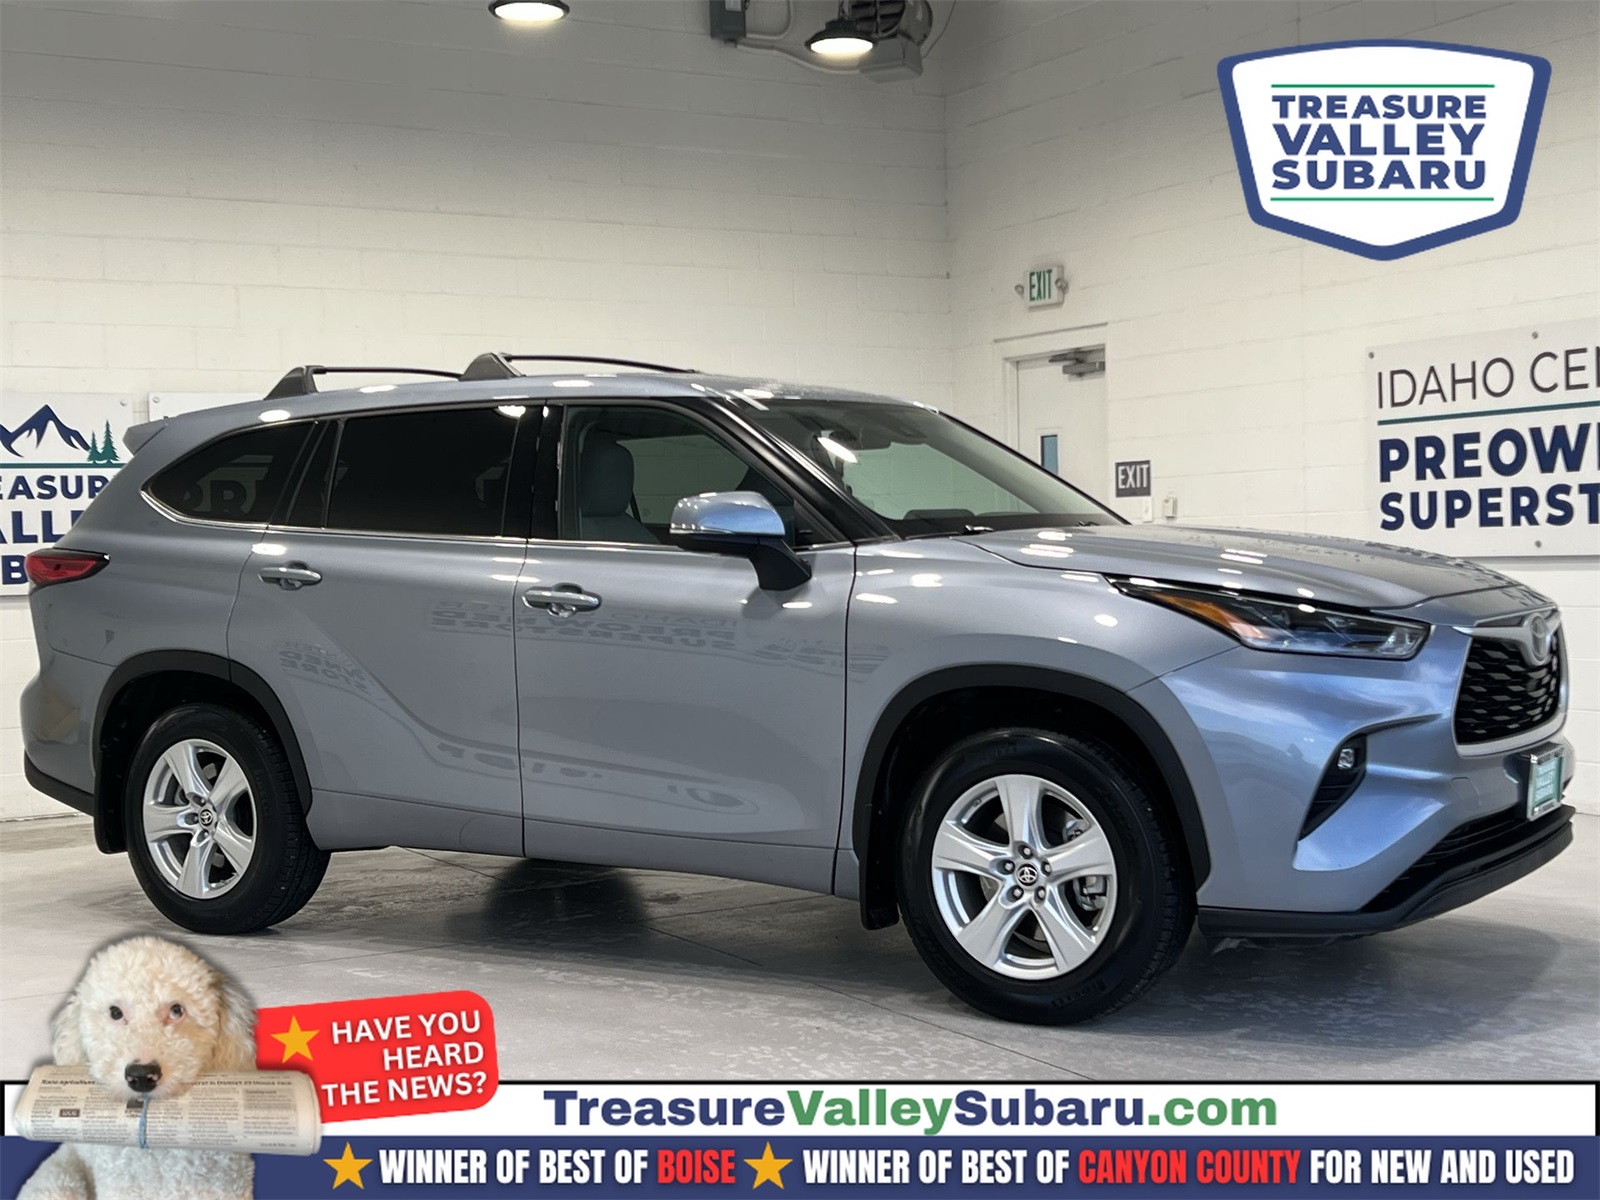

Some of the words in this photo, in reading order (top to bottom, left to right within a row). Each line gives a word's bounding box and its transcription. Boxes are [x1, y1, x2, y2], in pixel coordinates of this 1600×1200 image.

[1029, 269, 1053, 301] EXIT
[1377, 357, 1514, 409] IDAHO
[1530, 346, 1600, 393] CE
[1379, 422, 1600, 483] PREOW
[0, 475, 110, 499] ASUR
[1117, 463, 1150, 489] EXIT
[1380, 483, 1600, 531] SUPERST
